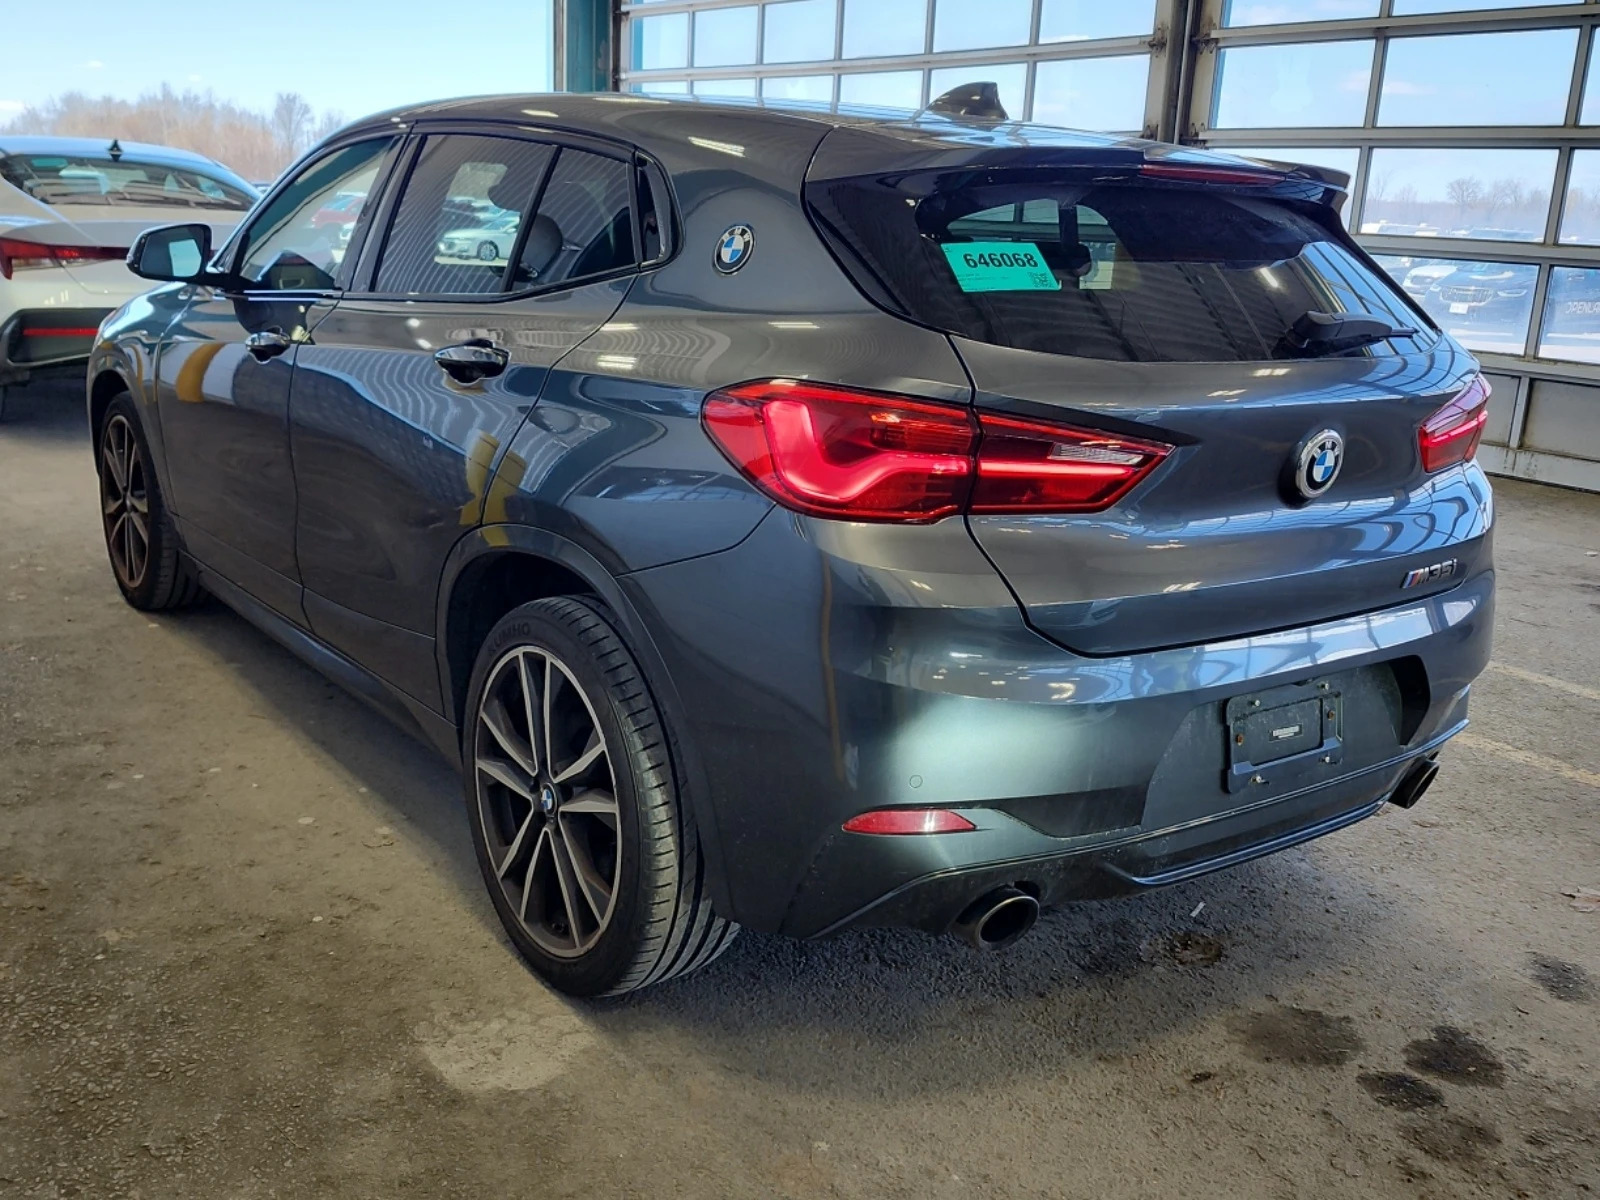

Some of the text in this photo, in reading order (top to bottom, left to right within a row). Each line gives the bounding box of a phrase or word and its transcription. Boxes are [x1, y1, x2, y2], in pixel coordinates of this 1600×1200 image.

[962, 252, 1039, 269] 646068
[1408, 557, 1458, 586] M35i
[487, 621, 531, 656] KUMHO
